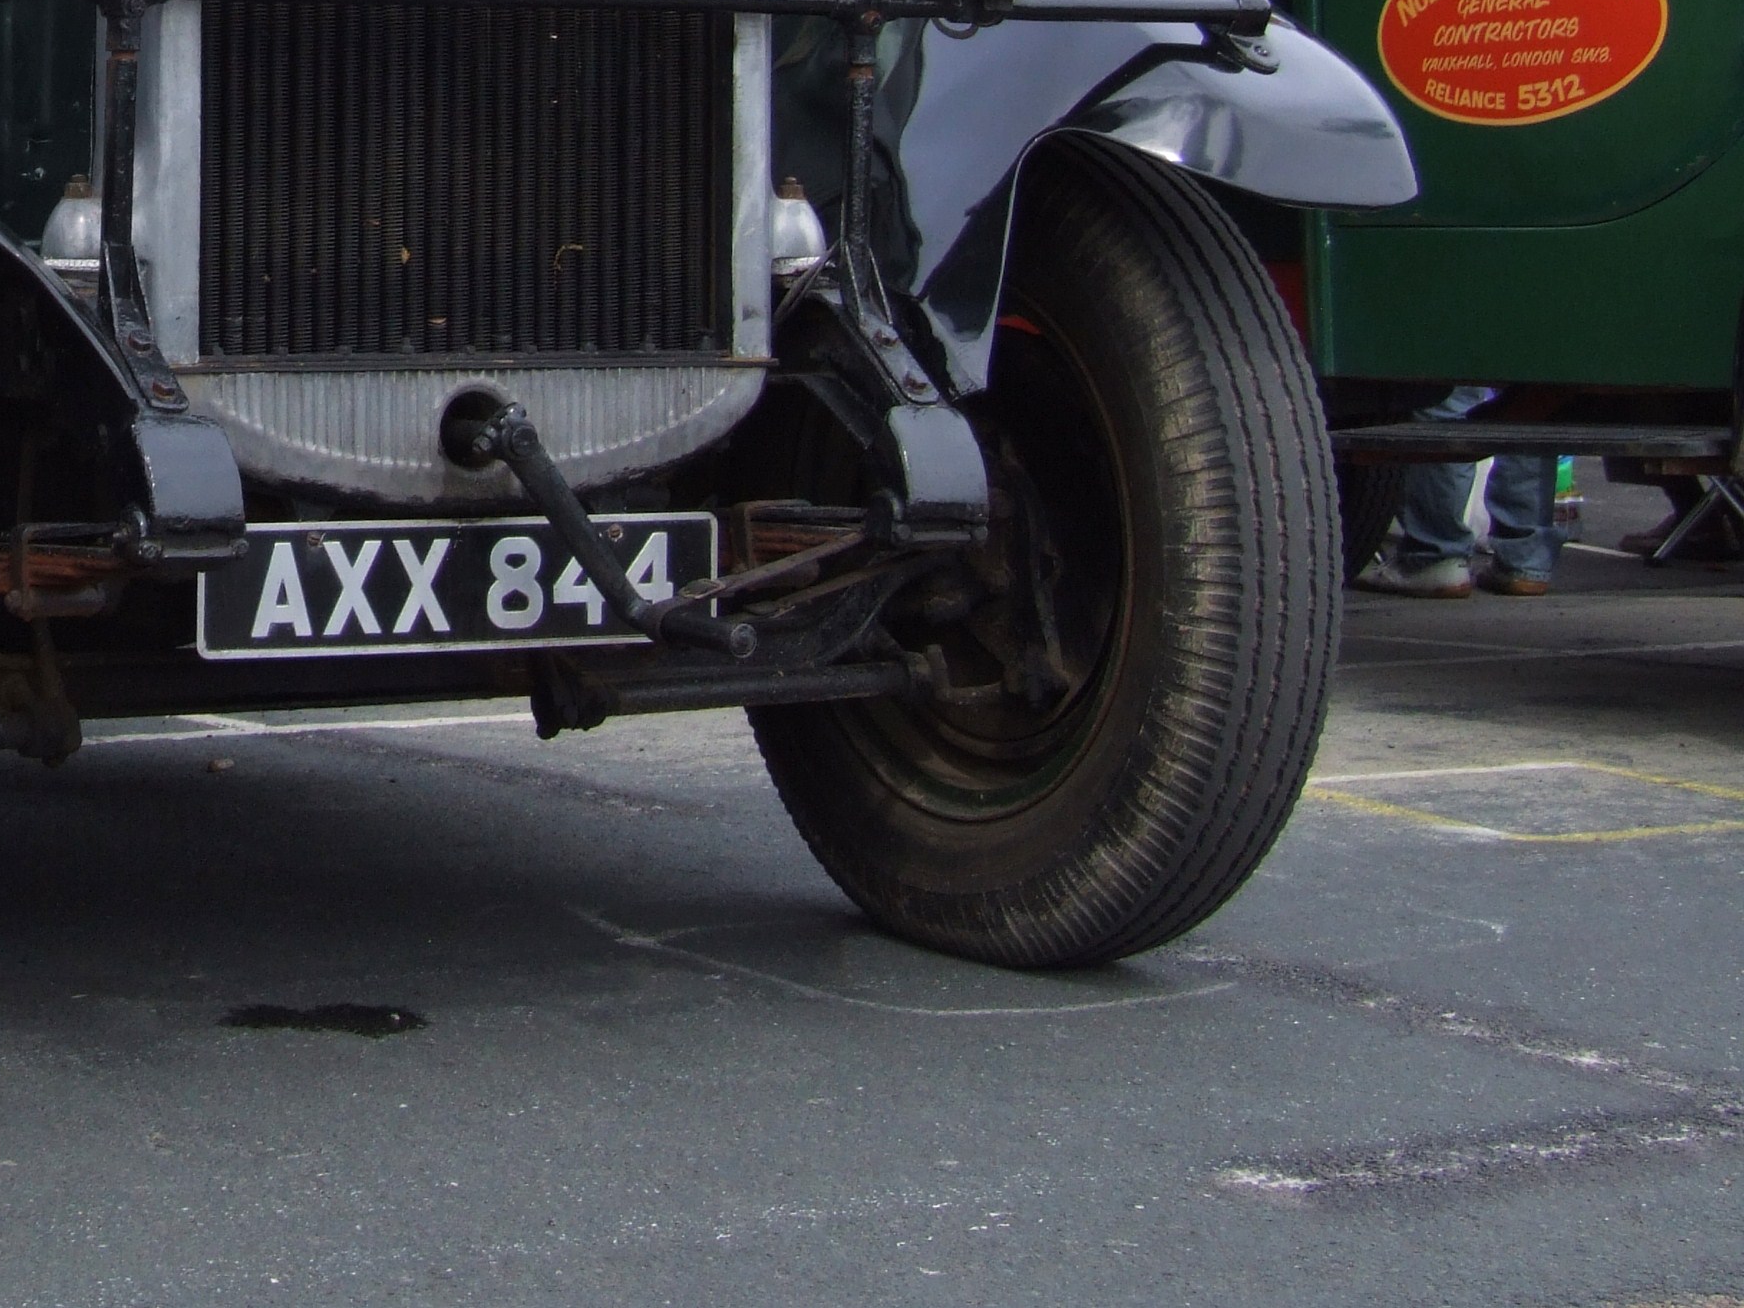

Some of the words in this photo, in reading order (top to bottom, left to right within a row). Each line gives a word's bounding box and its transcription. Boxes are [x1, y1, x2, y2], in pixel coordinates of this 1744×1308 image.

[1433, 17, 1579, 47] CONTRACTORS
[1422, 52, 1497, 73] VAUXHALL,
[1502, 49, 1565, 68] LONDON
[1424, 78, 1506, 110] RELIANCE
[1517, 73, 1585, 110] 5312
[251, 538, 452, 638] AXX
[486, 532, 674, 630] 844
